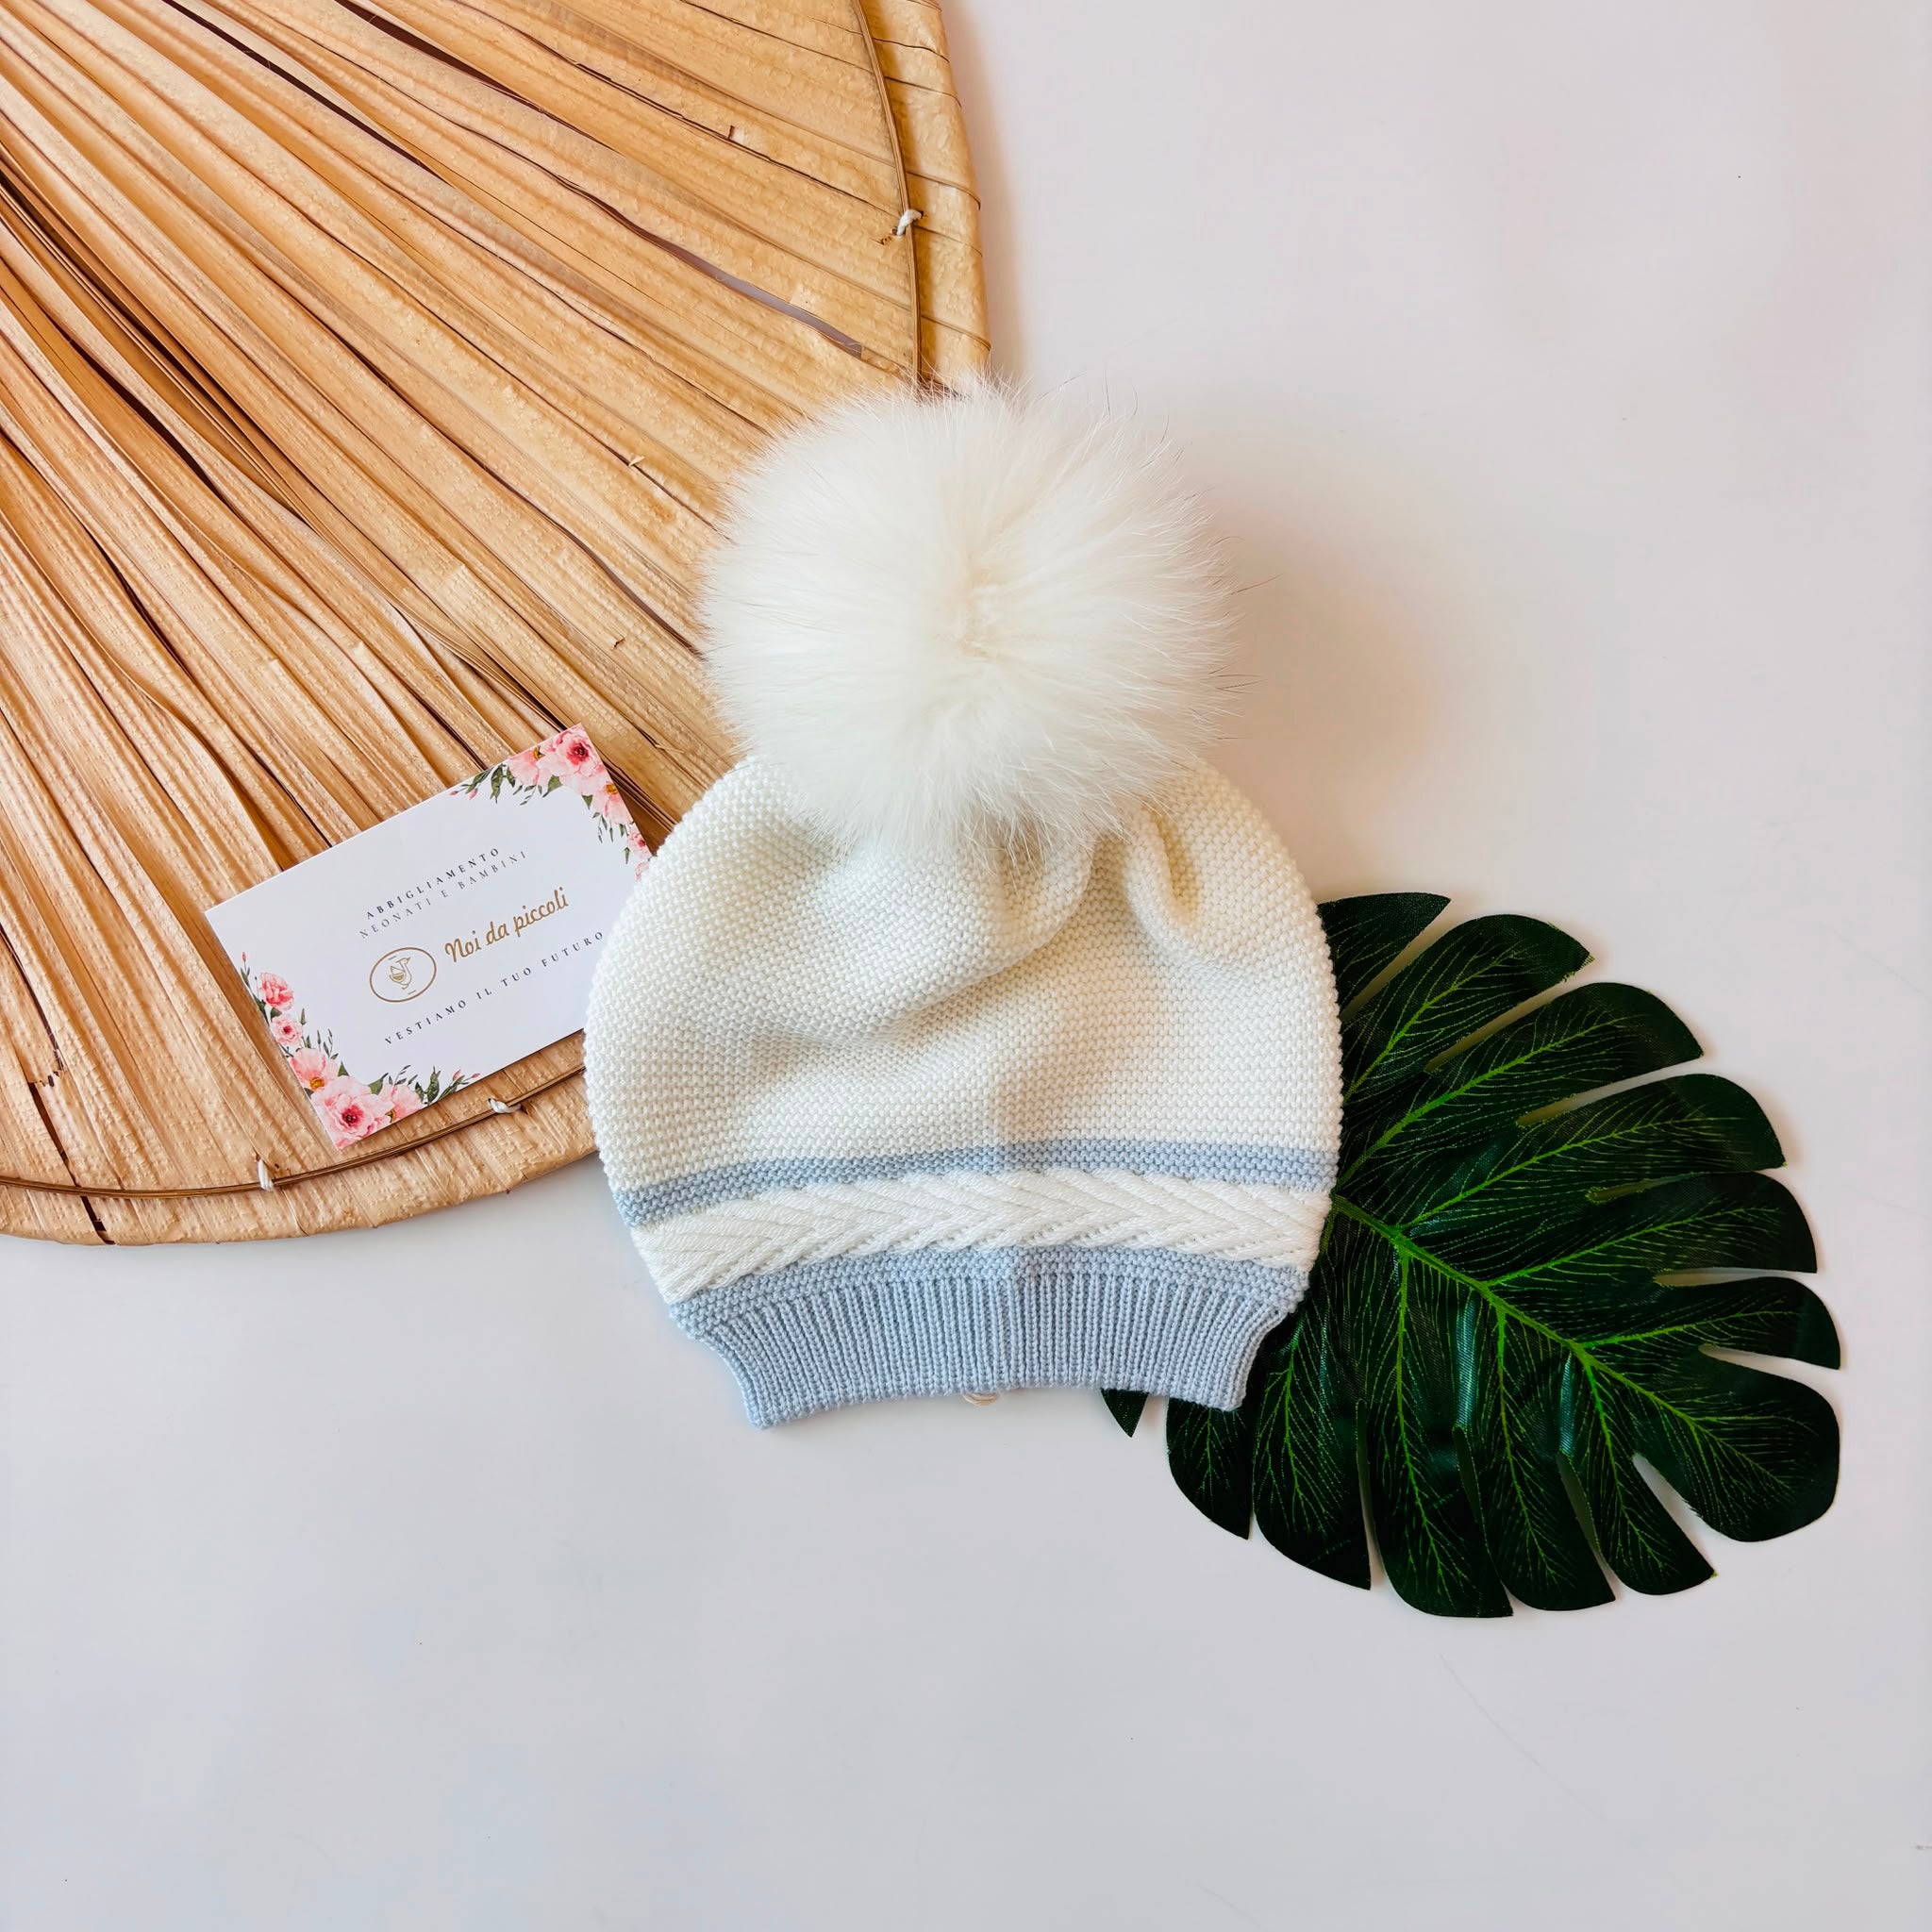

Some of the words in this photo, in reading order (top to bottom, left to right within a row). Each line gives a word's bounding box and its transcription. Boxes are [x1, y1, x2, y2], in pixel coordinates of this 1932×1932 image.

[359, 898, 431, 939] NEONATI
[441, 889, 448, 898] E
[458, 850, 526, 889] BAMBINI
[366, 848, 499, 920] ABBIGLIAMENTO
[444, 930, 481, 963] Noi
[486, 922, 509, 946] da
[513, 887, 569, 938] piccoli
[384, 1000, 467, 1045] VESTIAMO
[476, 988, 492, 1000] IL
[501, 967, 532, 988] TUO
[541, 931, 604, 967] FUTURO
